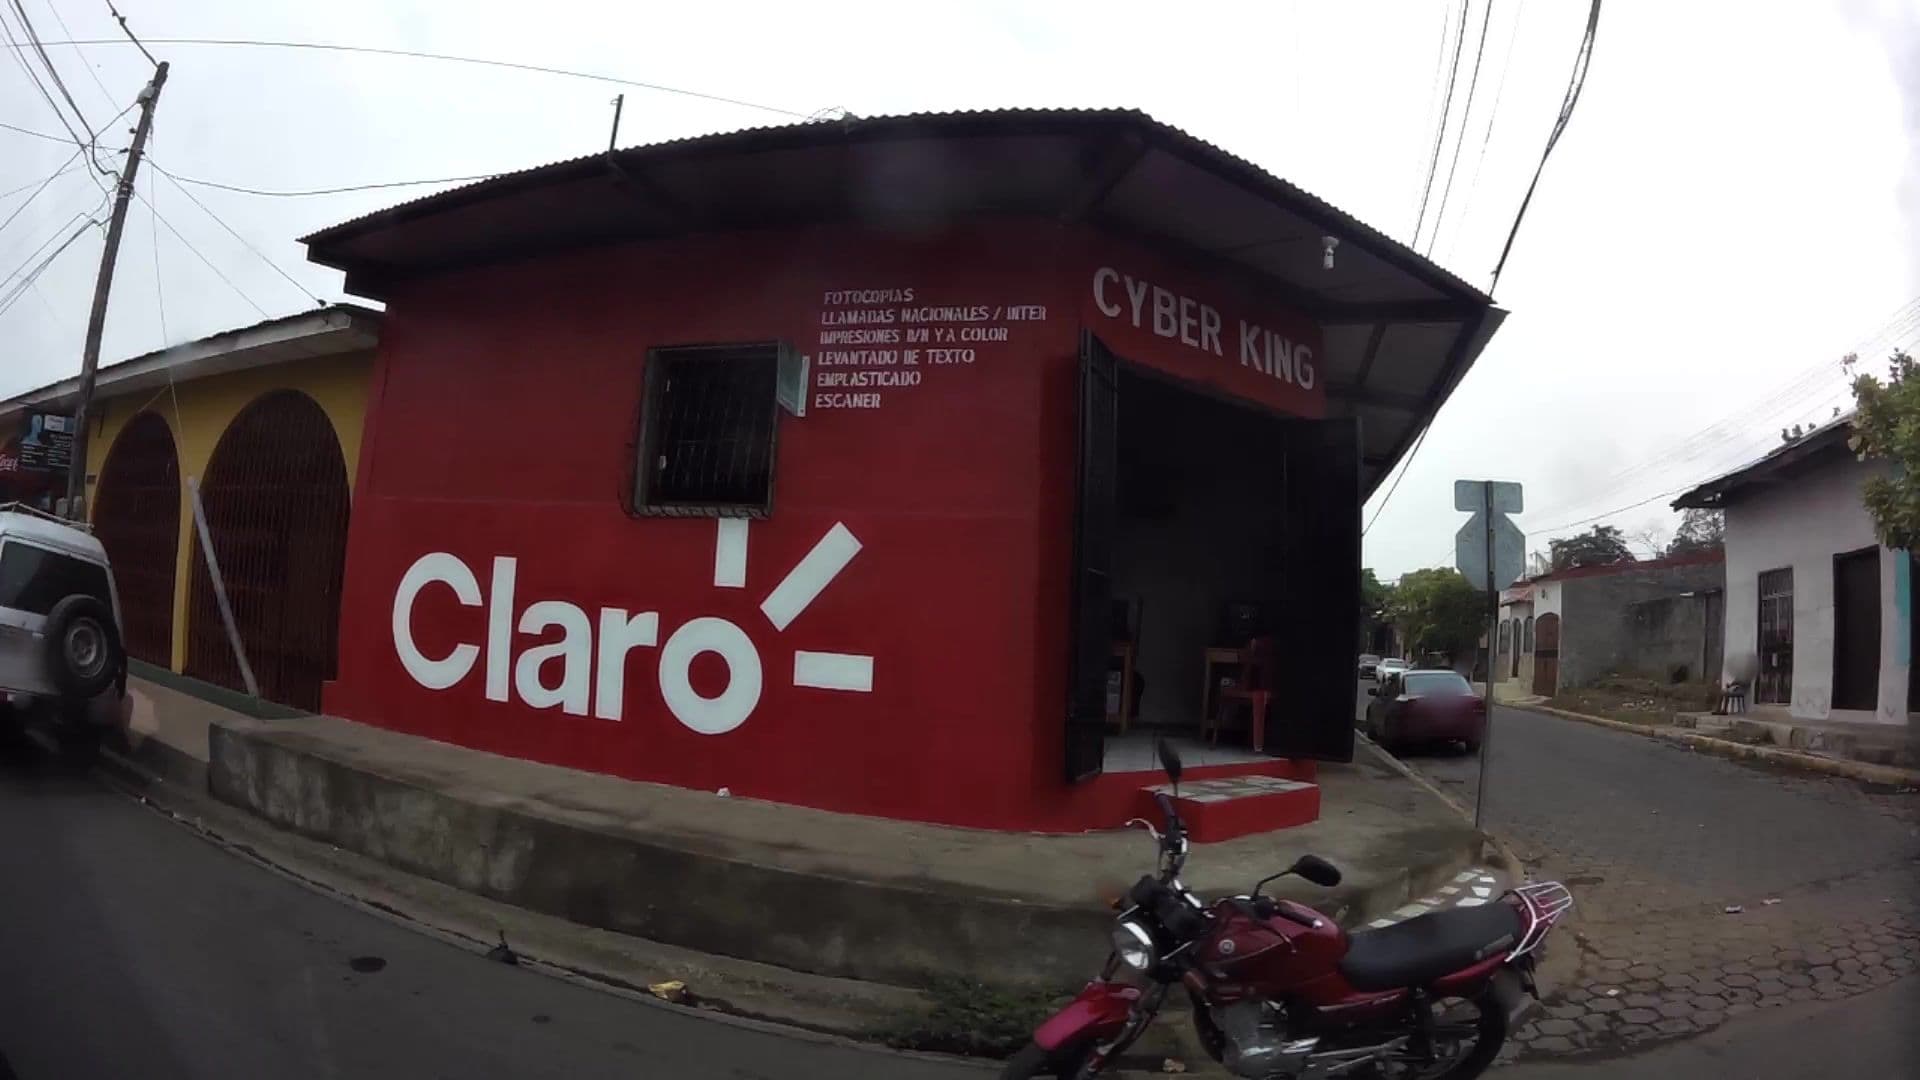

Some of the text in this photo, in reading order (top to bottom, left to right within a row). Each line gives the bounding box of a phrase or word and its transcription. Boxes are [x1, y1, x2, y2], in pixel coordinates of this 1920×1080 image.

[824, 288, 914, 305] FOTOCOPIAS
[821, 308, 895, 325] LLAMADAS
[901, 306, 990, 323] NACIONALES
[1006, 305, 1047, 321] INTER
[819, 328, 900, 345] IMPRESIONES
[961, 327, 1009, 342] COLOR
[1092, 266, 1314, 391] CYBER KING
[817, 348, 976, 366] LEVANTADO DE TEXTO
[816, 371, 921, 387] EMPLASTICADO
[815, 393, 881, 409] ESCANER
[392, 552, 763, 735] Claro
